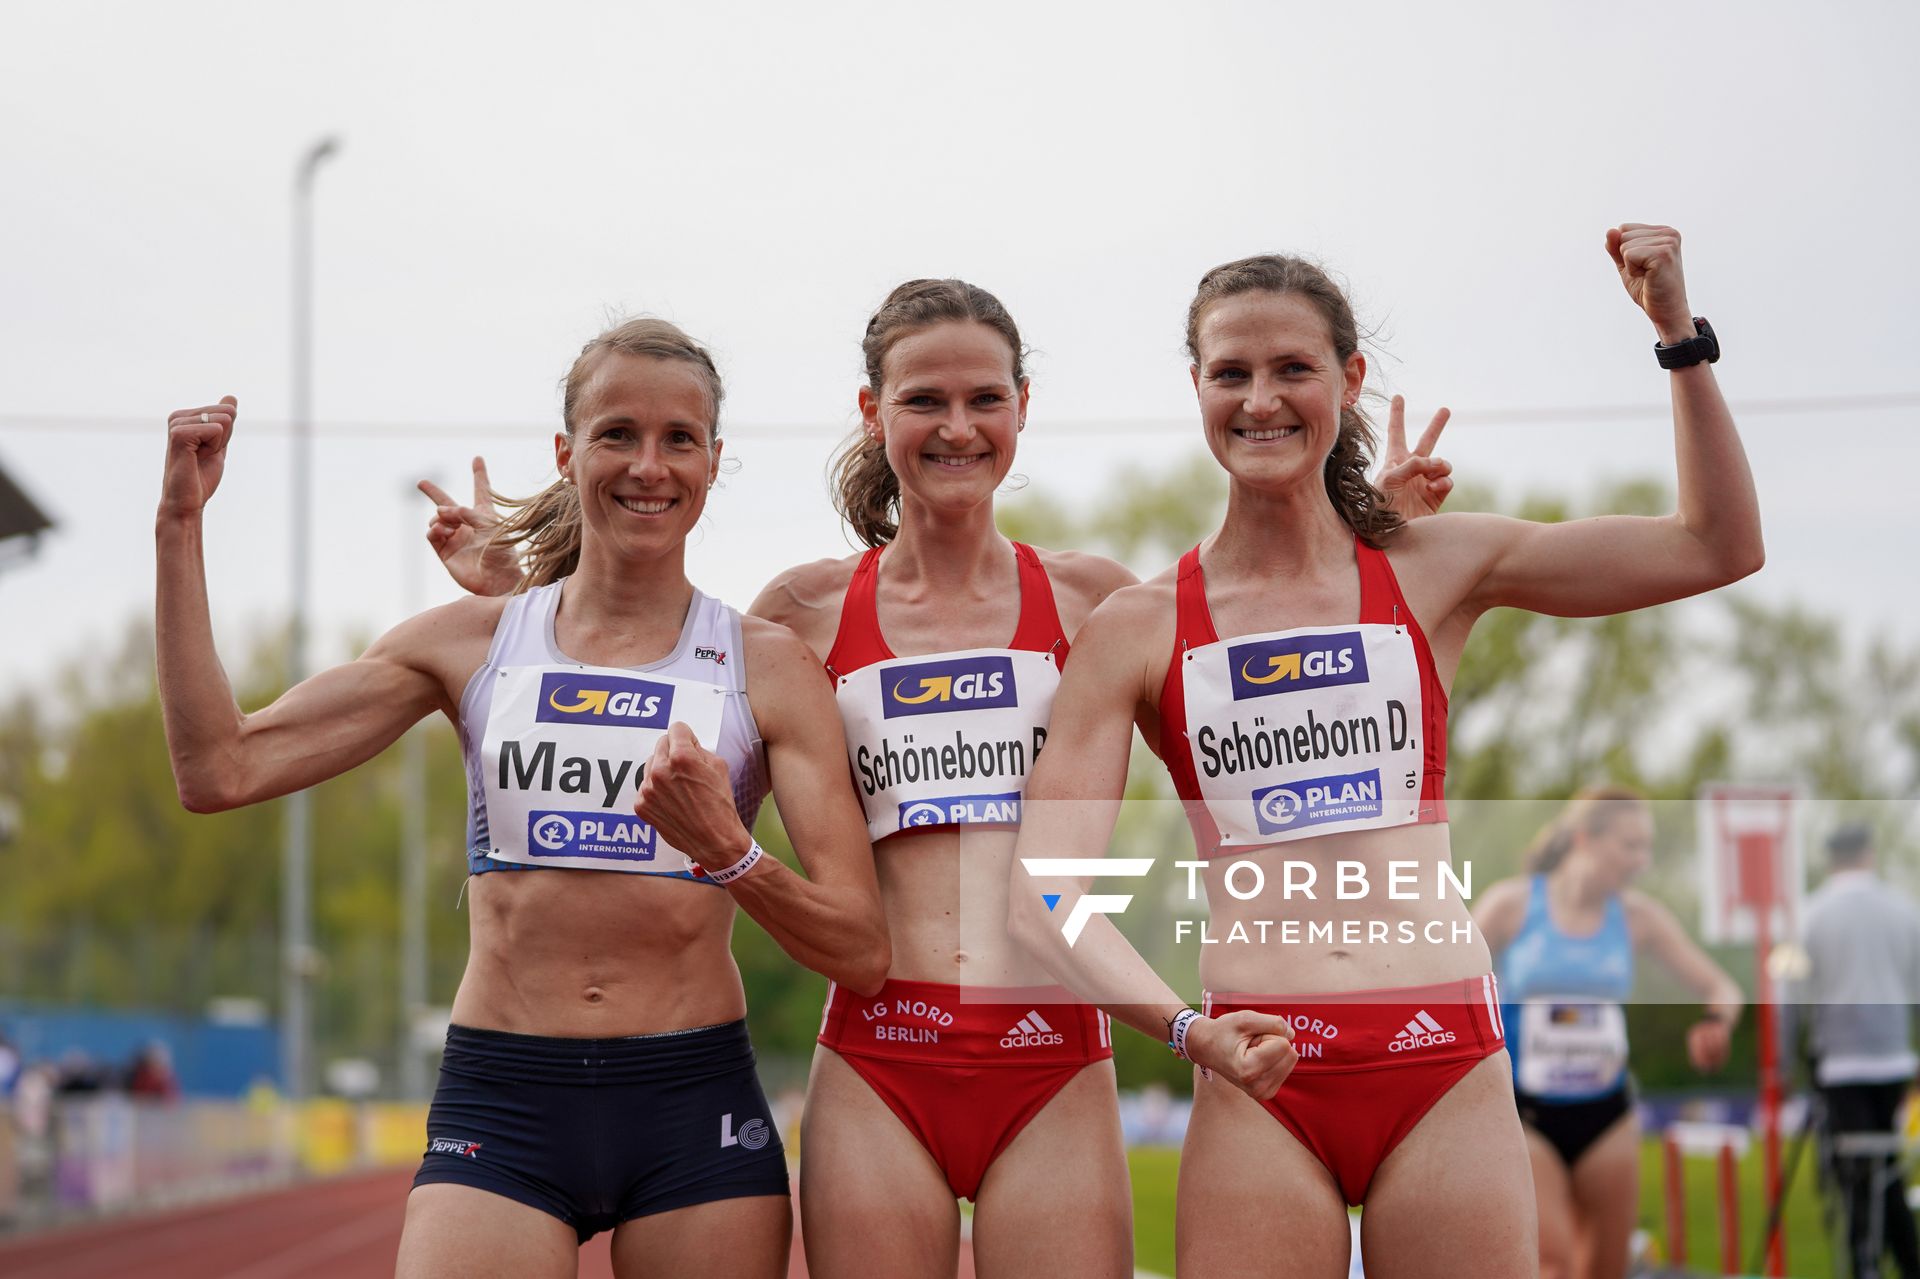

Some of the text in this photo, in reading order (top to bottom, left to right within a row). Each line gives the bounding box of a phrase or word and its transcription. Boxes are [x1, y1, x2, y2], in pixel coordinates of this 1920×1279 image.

[1303, 648, 1354, 677] GLS
[953, 672, 1004, 700] GLS
[607, 692, 661, 718] GLS
[1198, 699, 1416, 778] Schöneborn D.
[857, 730, 1025, 796] Schöneborn
[1405, 770, 1416, 789] 10
[1306, 780, 1377, 808] PLAN
[950, 801, 1018, 824] PLAN
[1309, 804, 1378, 819] INTERNATIONAL
[579, 820, 651, 844] PLAN
[579, 843, 650, 855] INTERNATIONAL
[862, 1000, 954, 1027] LG NORD
[875, 1025, 938, 1044] BERLIN
[1000, 1032, 1064, 1049] adidas
[1388, 1031, 1457, 1053] adidas
[721, 1113, 770, 1150] LG
